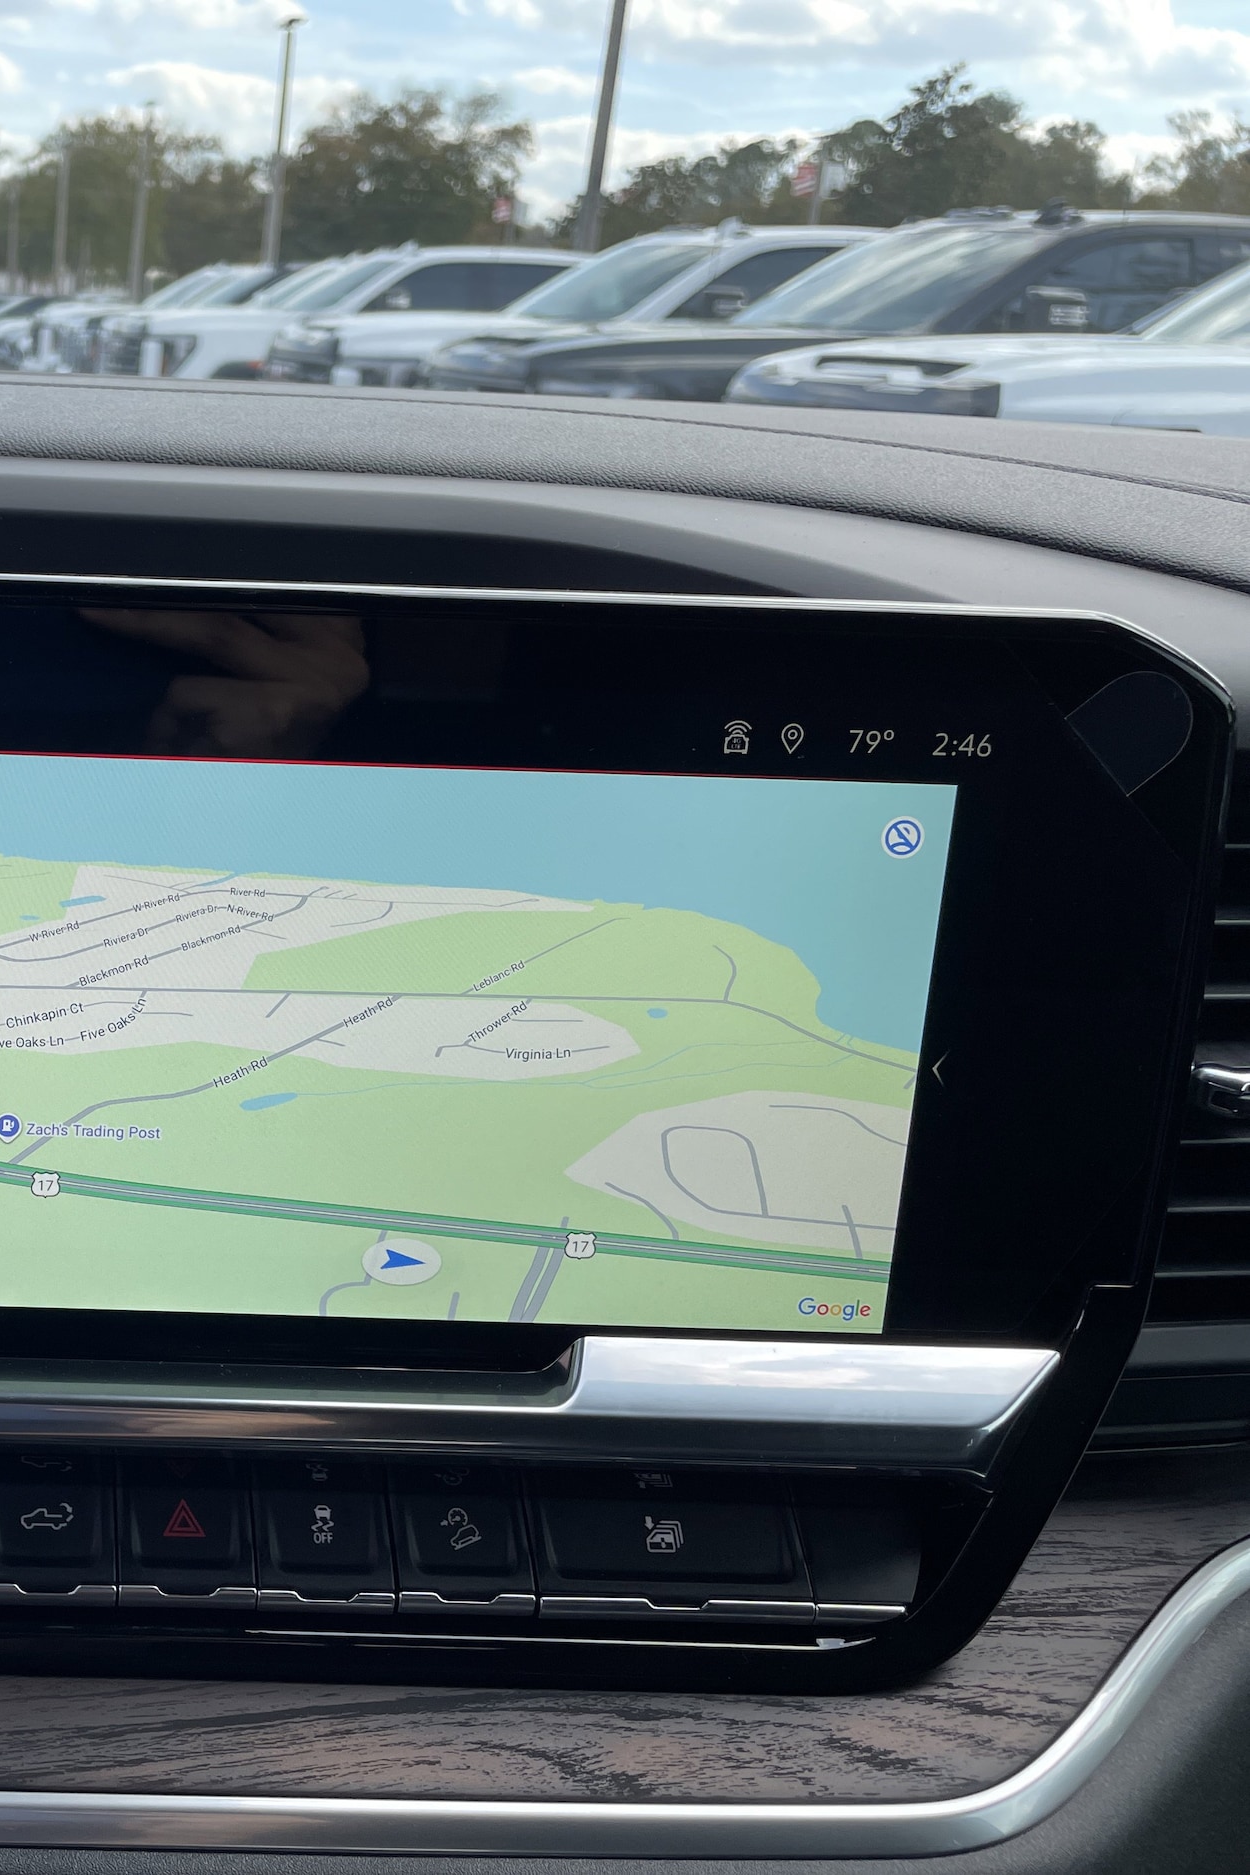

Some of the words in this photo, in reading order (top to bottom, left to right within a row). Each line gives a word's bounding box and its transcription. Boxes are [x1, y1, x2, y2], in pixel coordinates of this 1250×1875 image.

[932, 732, 992, 757] 2:46
[132, 903, 143, 913] W
[143, 897, 168, 909] River
[168, 893, 180, 903] Rd
[230, 887, 251, 896] River
[253, 888, 266, 898] Rd
[175, 907, 206, 923] Riviera
[207, 904, 218, 913] Dr
[226, 904, 236, 913] N
[236, 906, 261, 919] River
[261, 913, 274, 922] Rd
[29, 931, 40, 942] W
[41, 927, 66, 939] River
[66, 920, 80, 933] Rd
[103, 931, 137, 948] Riviera
[137, 927, 149, 938] Dr
[181, 930, 228, 952] Blackmon
[227, 924, 242, 935] Rd
[78, 962, 133, 987] Blackmon
[133, 955, 149, 970] Rd
[473, 968, 511, 992] Leblanc
[510, 960, 526, 974] Rd
[6, 1007, 68, 1029] Chinkapin
[69, 1002, 85, 1014] Ct
[79, 1028, 106, 1042] Five
[107, 1012, 137, 1034] Oaks
[132, 997, 147, 1015] Ln
[343, 1006, 378, 1028] Heath
[377, 996, 394, 1012] Rd
[468, 1012, 512, 1043] Thrower
[511, 1000, 528, 1016] Rd
[15, 1036, 47, 1048] Oaks
[49, 1036, 65, 1047] Ln
[505, 1047, 552, 1063] Virginia
[556, 1047, 571, 1059] Ln
[213, 1065, 251, 1088] Heath
[249, 1055, 269, 1073] Rd
[26, 1123, 69, 1136] Zach's
[73, 1124, 124, 1141] Trading
[127, 1126, 161, 1140] Post
[37, 1179, 54, 1193] 17
[572, 1240, 589, 1252] 17
[797, 1296, 872, 1322] Google
[313, 1532, 333, 1544] OFF
